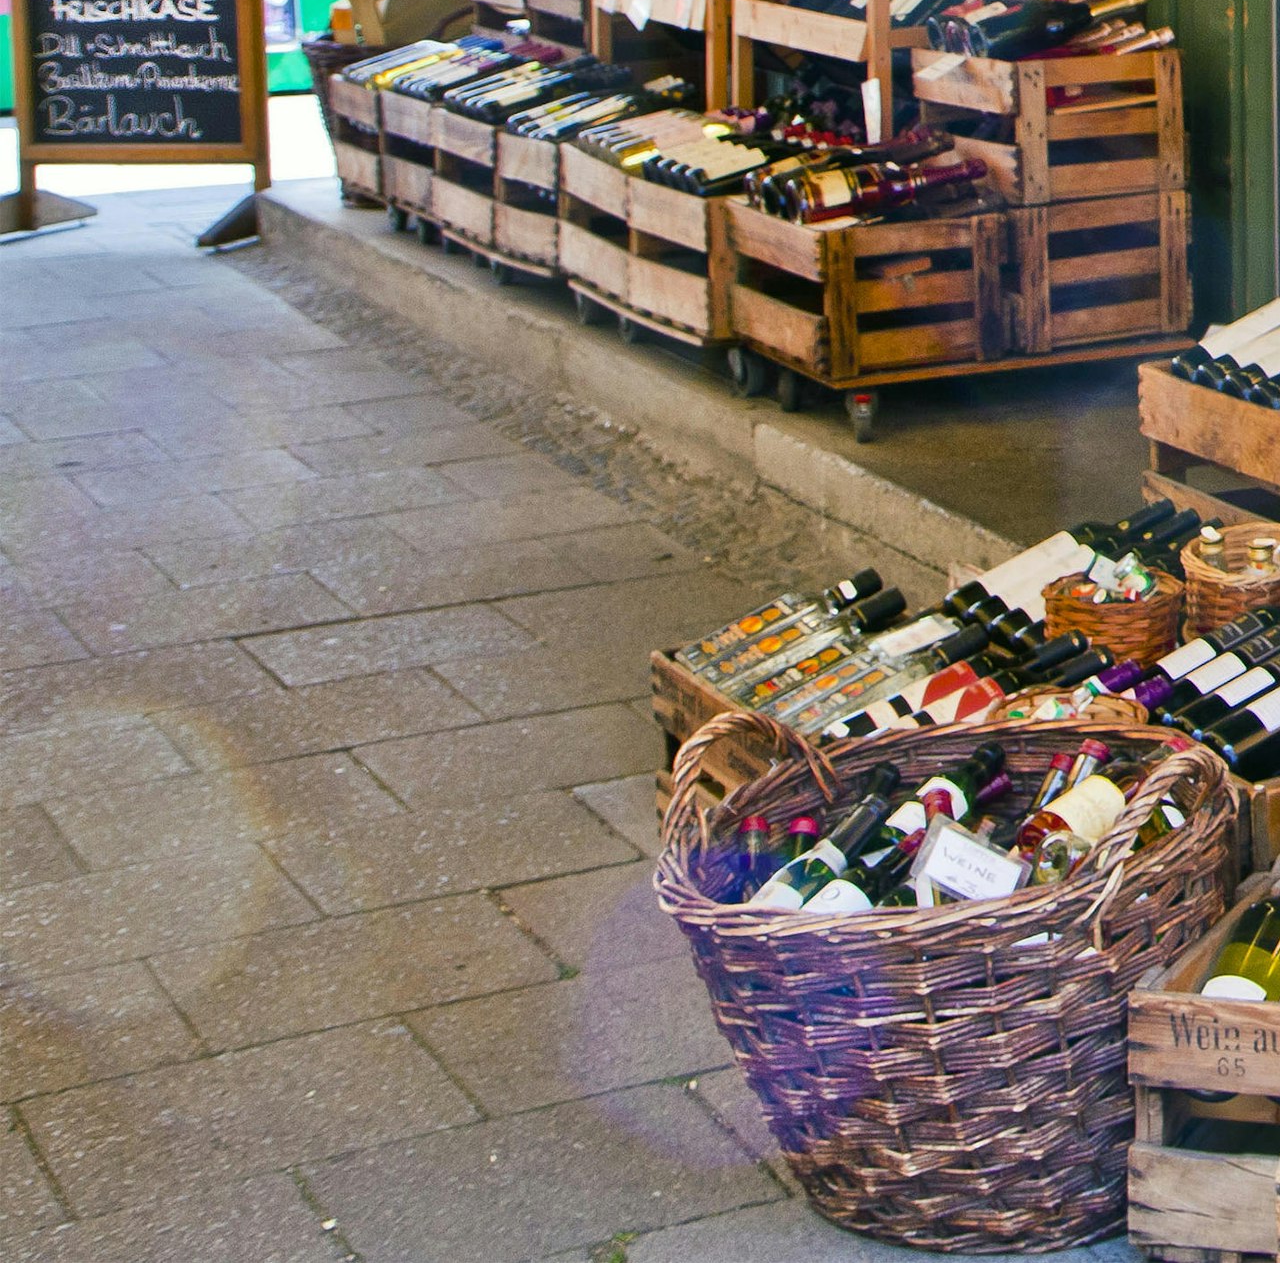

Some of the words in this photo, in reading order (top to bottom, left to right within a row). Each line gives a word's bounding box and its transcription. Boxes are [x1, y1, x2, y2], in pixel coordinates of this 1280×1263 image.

[41, 94, 203, 139] Bärlauch
[943, 845, 998, 884] WEINE
[1169, 1011, 1241, 1052] Wein
[1216, 1056, 1246, 1079] 65
